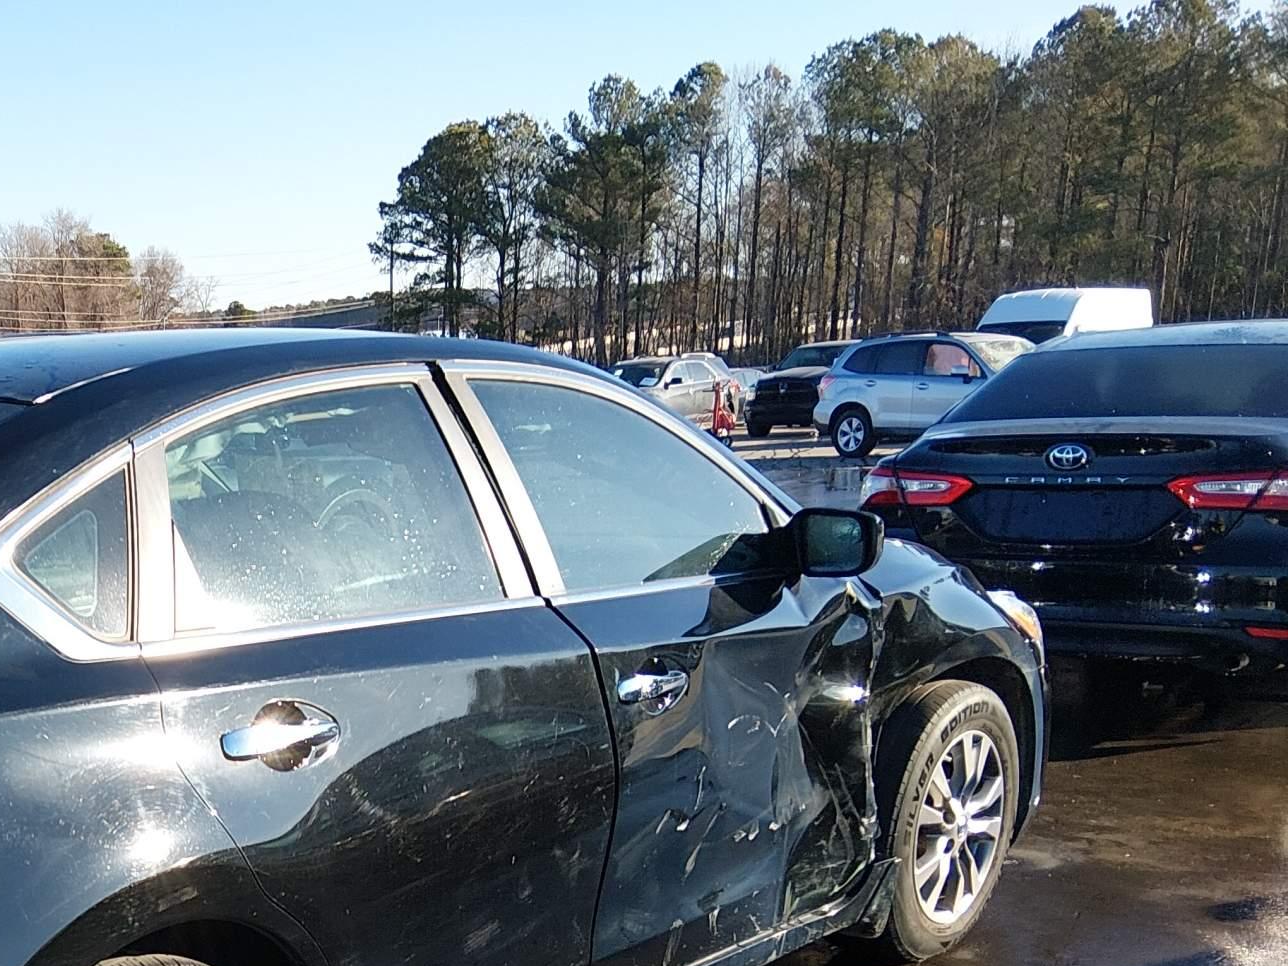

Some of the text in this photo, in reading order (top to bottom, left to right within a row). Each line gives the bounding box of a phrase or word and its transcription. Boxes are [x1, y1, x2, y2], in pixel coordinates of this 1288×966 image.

[1004, 476, 1133, 485] CAMRY
[903, 700, 990, 847] SILVER EDITION
